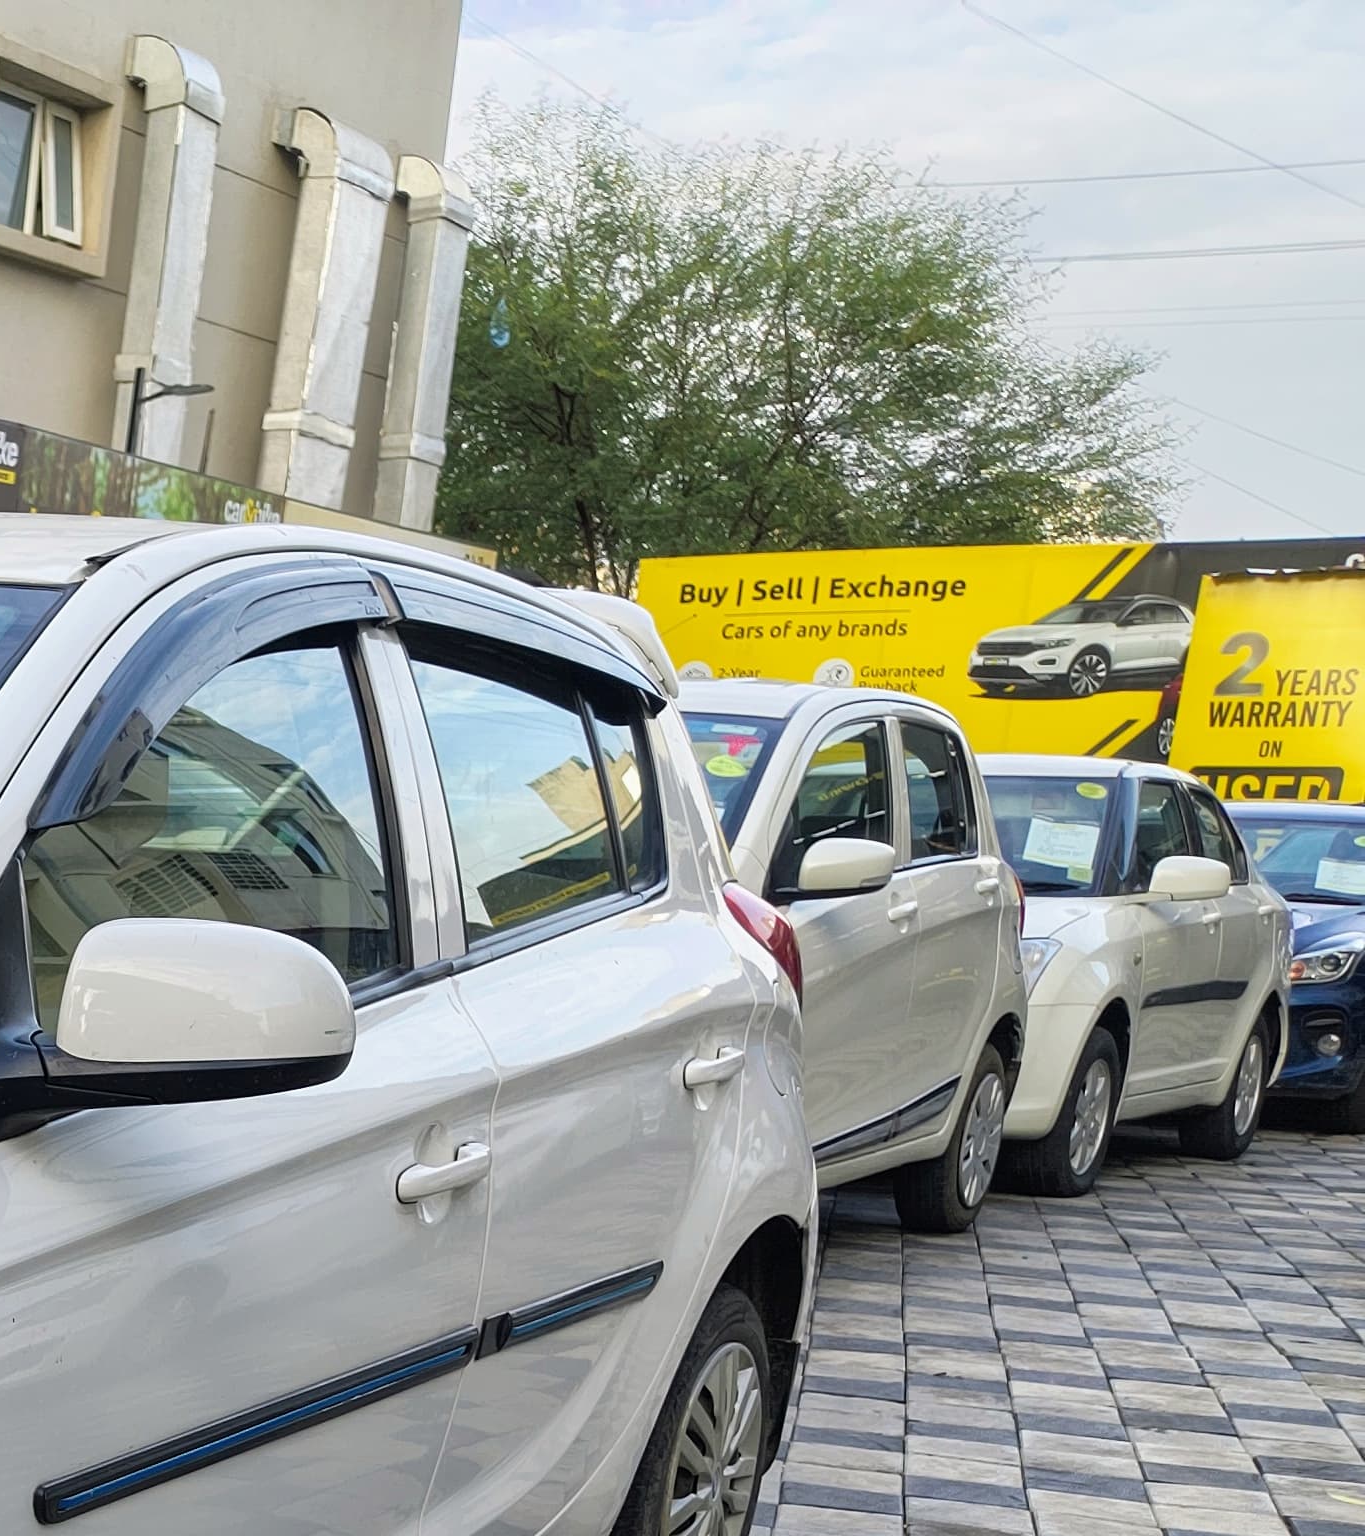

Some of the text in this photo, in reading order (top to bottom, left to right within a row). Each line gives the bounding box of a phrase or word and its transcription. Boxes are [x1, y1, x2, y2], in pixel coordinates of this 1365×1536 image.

[679, 583, 729, 608] Buy
[751, 578, 802, 602] Sell
[828, 574, 967, 602] Exchange
[721, 619, 909, 641] Cars of any brands
[860, 665, 945, 678] Guaranteed
[1214, 631, 1360, 697] 2 YEARS
[1208, 701, 1354, 728] WARRANTY
[1258, 740, 1283, 758] ON
